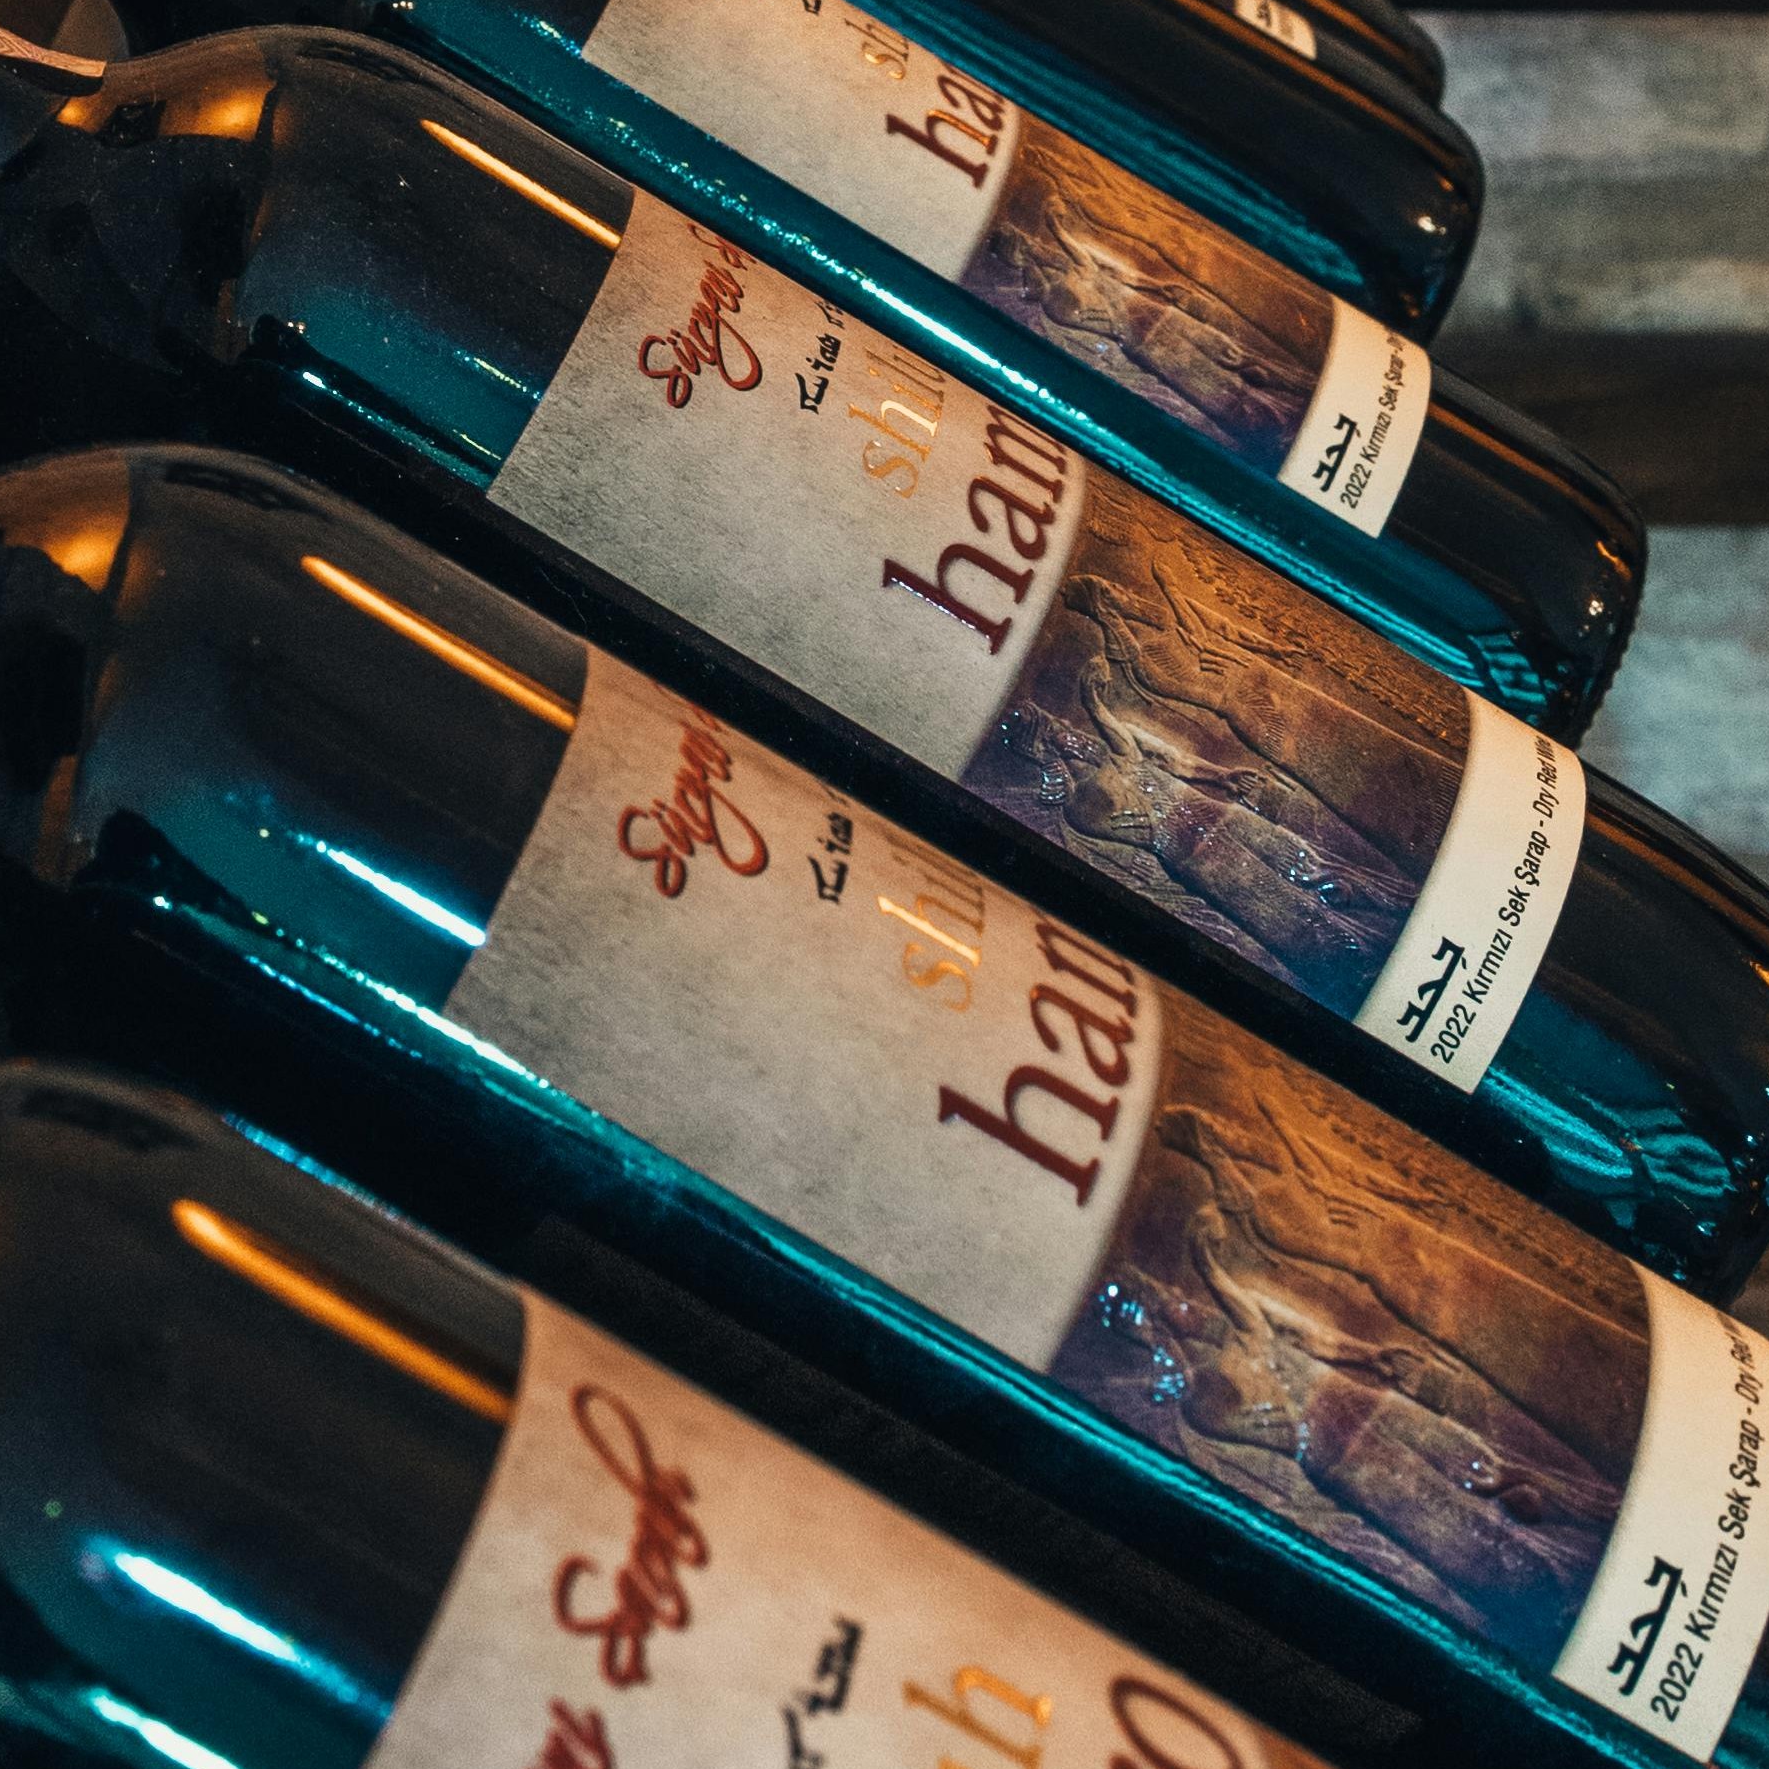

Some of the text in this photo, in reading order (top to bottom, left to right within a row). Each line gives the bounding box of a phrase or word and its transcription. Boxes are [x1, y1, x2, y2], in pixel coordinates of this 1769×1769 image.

[848, 344, 946, 499] shilu
[1340, 463, 1373, 510] 2022
[1378, 384, 1400, 412] Sek
[882, 404, 1069, 656] ham
[1532, 786, 1560, 819] Dry
[1535, 758, 1558, 789] Red
[1514, 828, 1552, 888] Şarap
[1498, 884, 1531, 928] Sek
[1462, 928, 1514, 1006] Kırmızı
[1429, 1003, 1477, 1064] 2022
[1734, 1370, 1764, 1405] Dry
[1728, 1417, 1766, 1489] Şarap
[1717, 1486, 1753, 1542] Sek
[1684, 1540, 1740, 1642] Kırmızı
[1650, 1641, 1705, 1723] 2022
